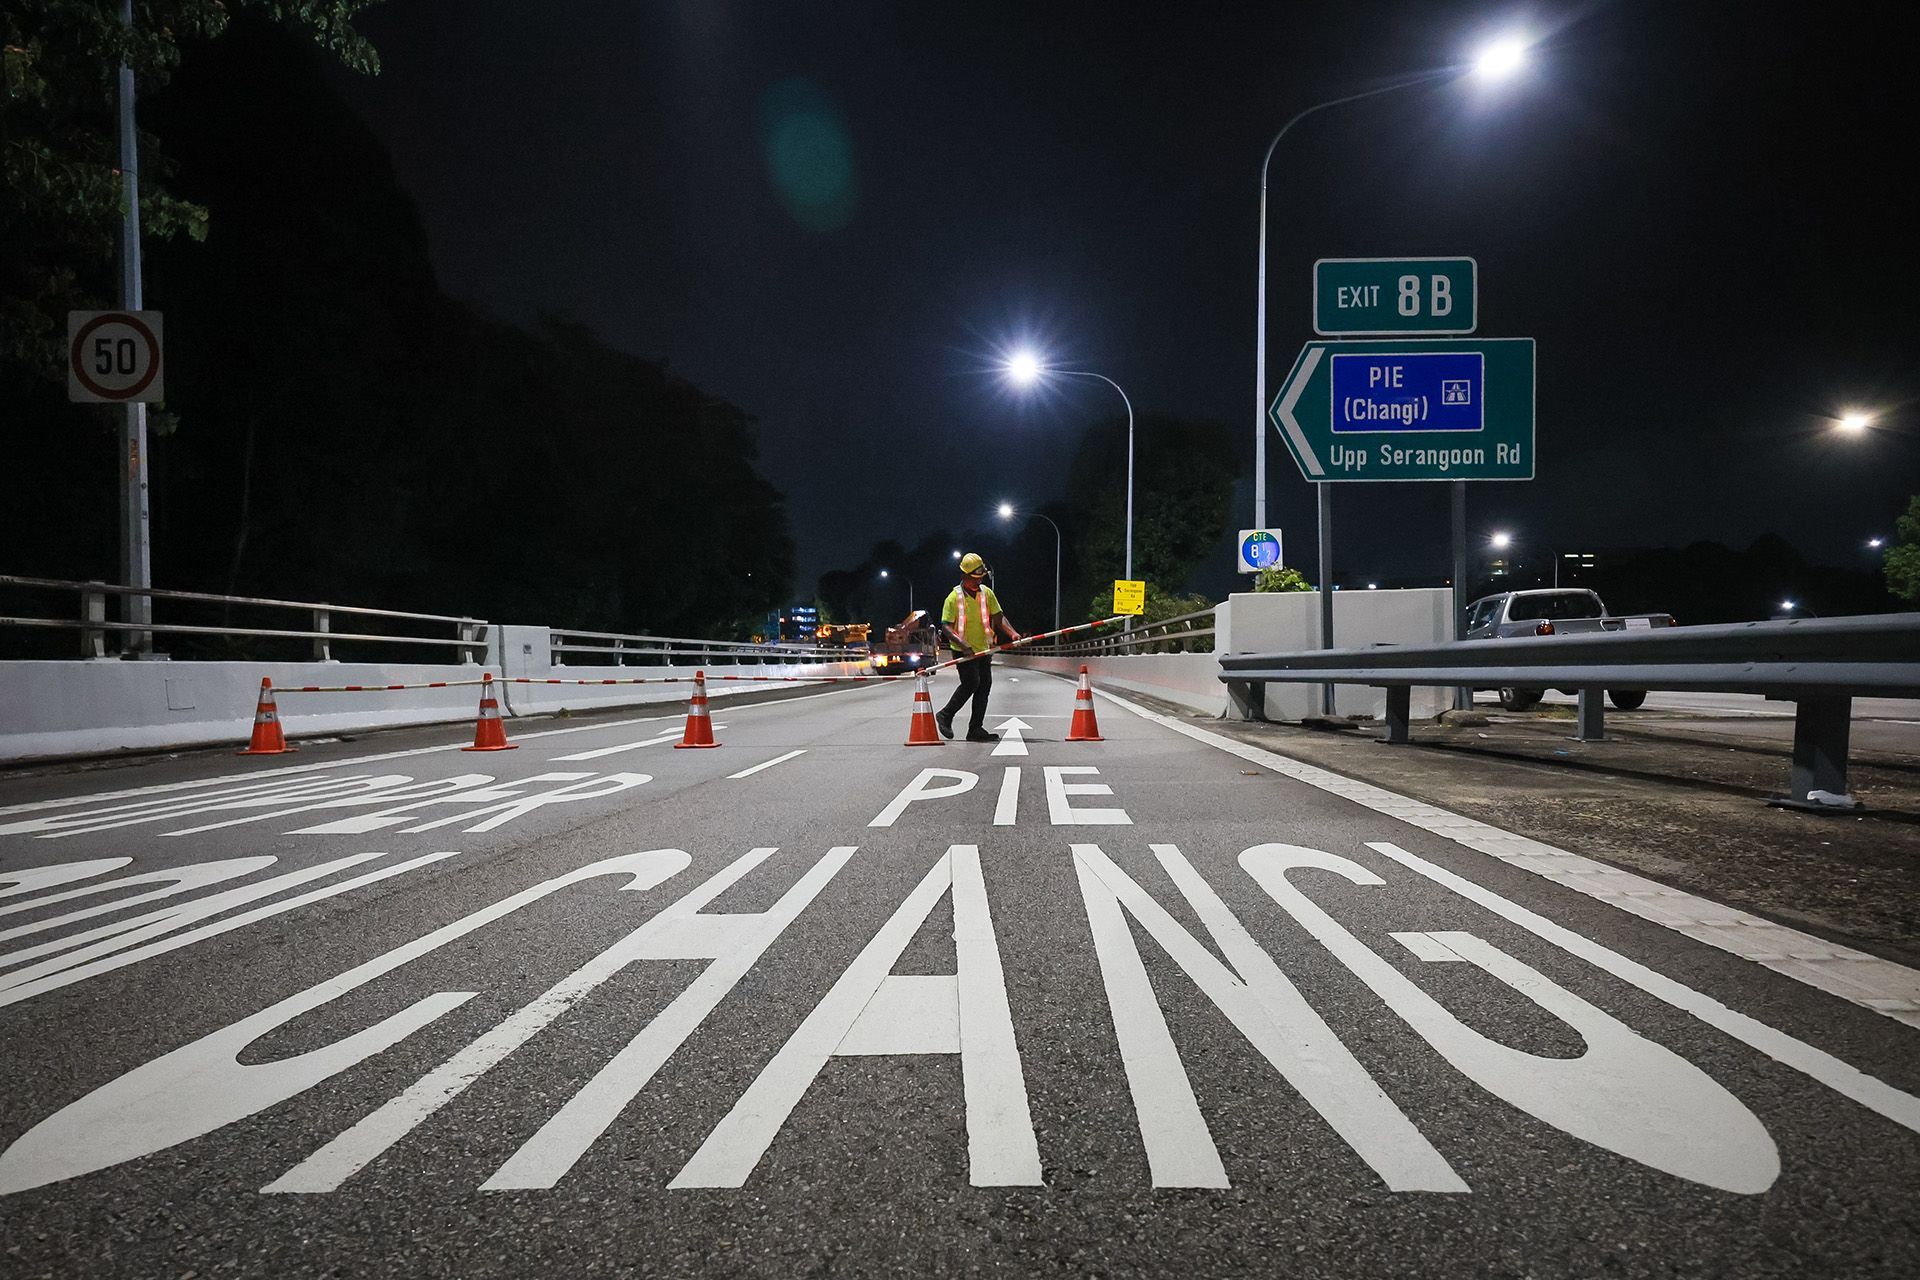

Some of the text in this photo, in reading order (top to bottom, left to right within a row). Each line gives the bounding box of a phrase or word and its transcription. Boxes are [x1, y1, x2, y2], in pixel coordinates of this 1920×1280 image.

[1337, 285, 1380, 309] EXIT
[95, 338, 136, 375] 50
[1369, 366, 1403, 388] PIE
[1344, 396, 1428, 424] (Changi)
[1331, 443, 1520, 471] Upp Serangoon Rd
[1253, 533, 1267, 541] CTE
[0, 772, 654, 838] UPPER
[867, 766, 1134, 827] PIE
[0, 840, 1920, 1194] CHANGI
